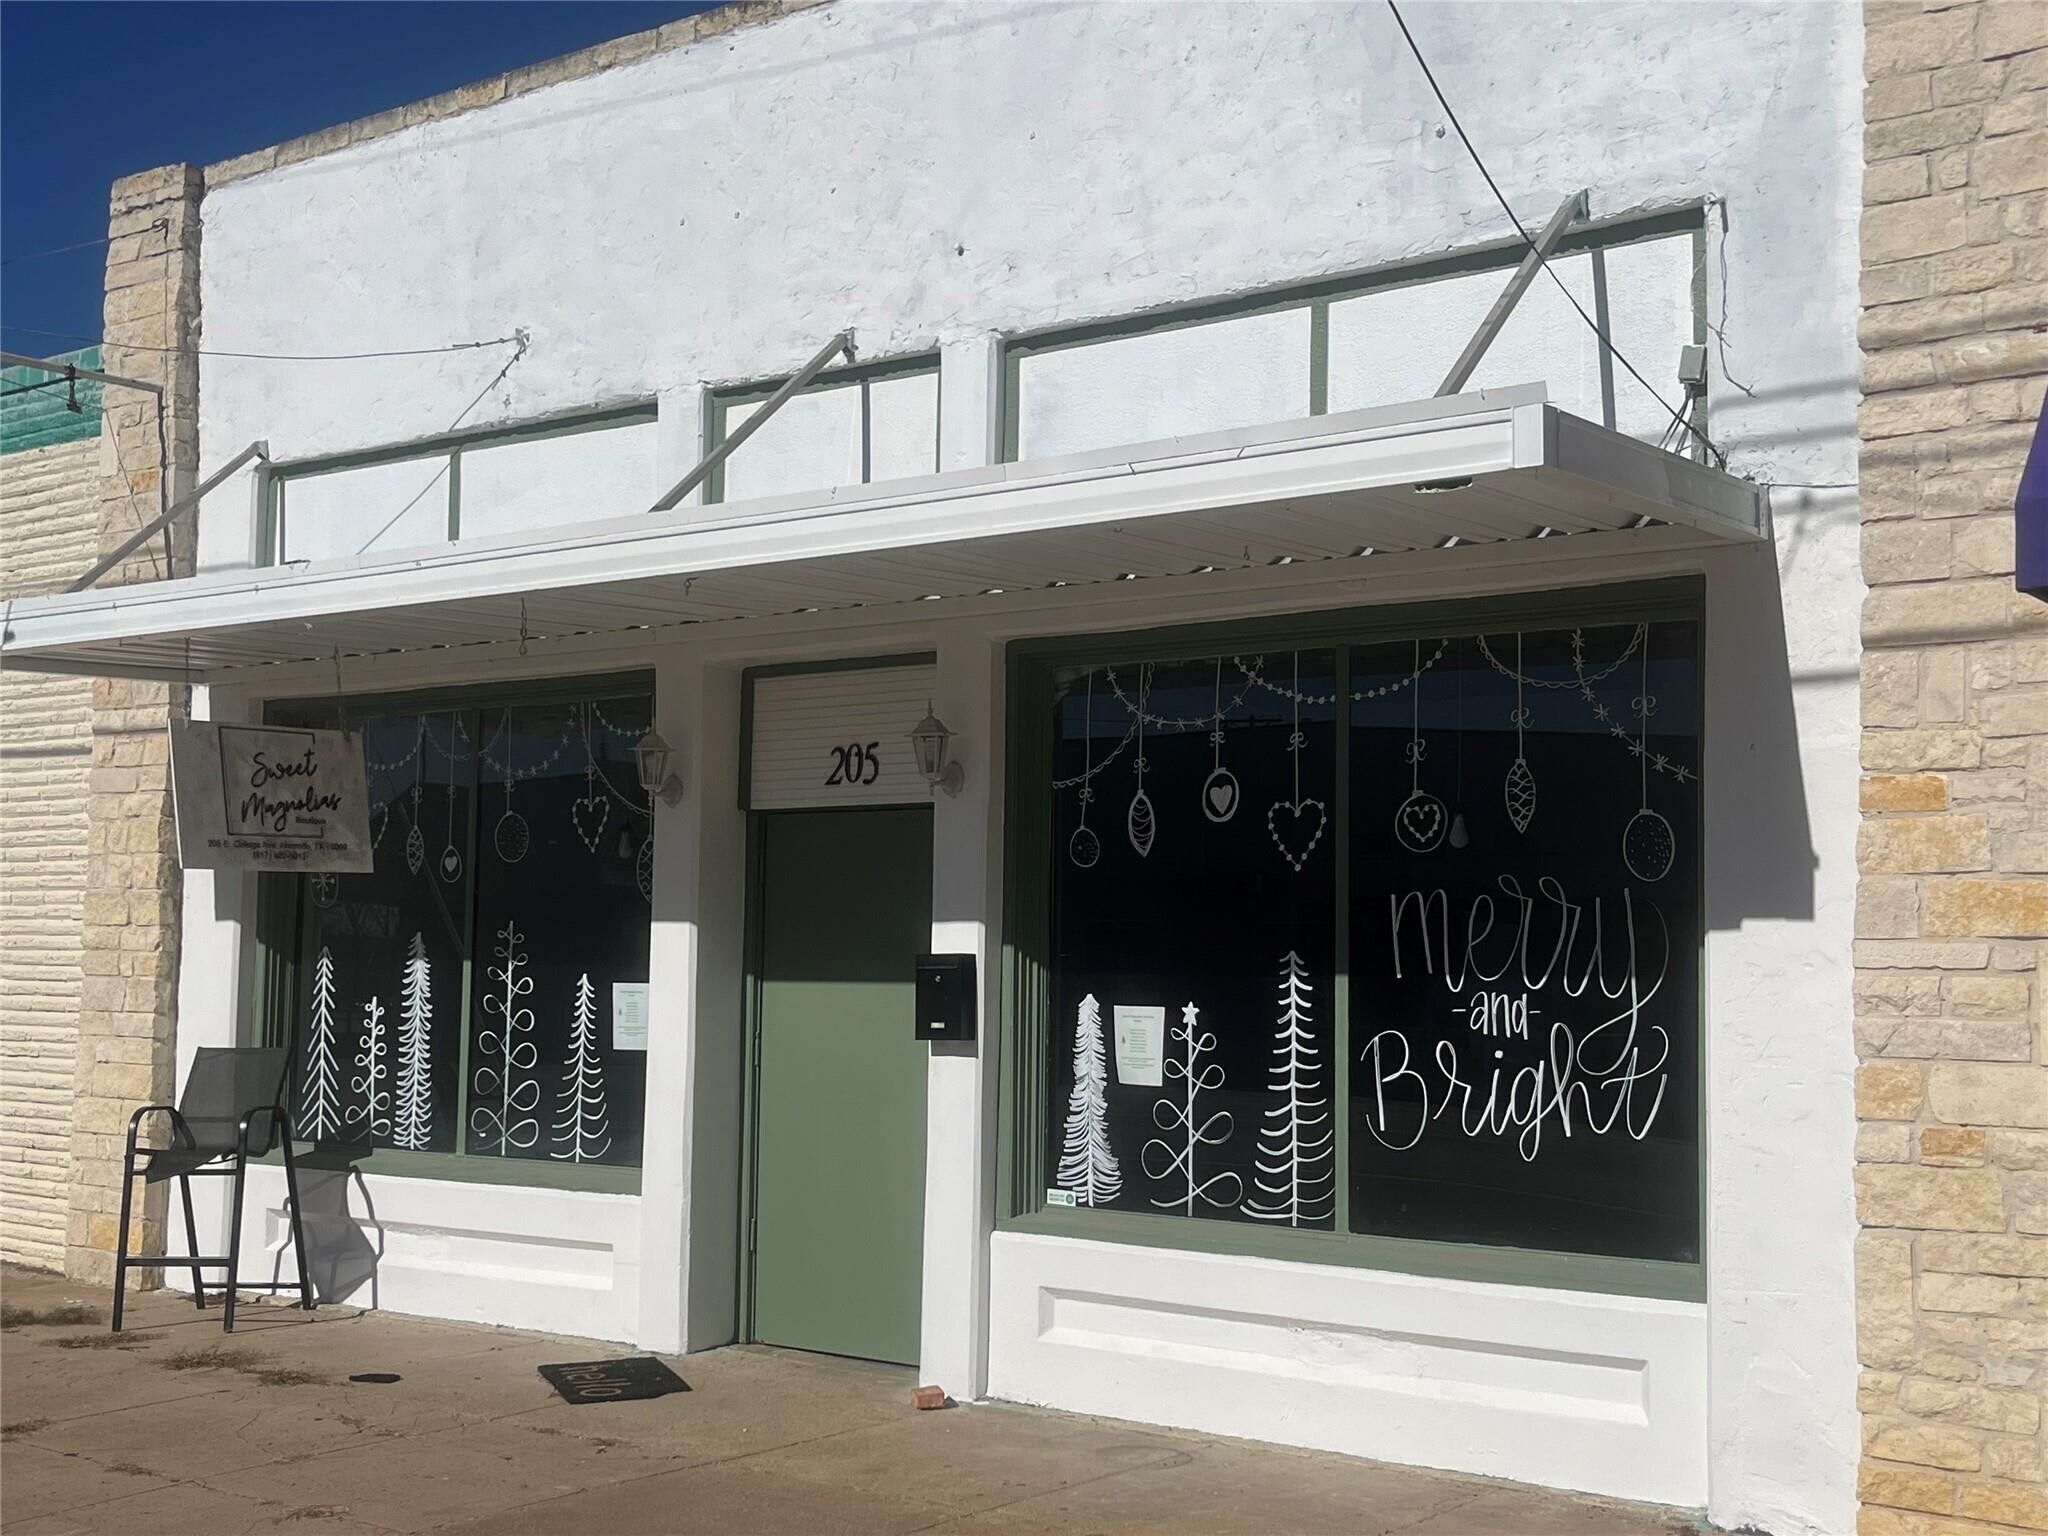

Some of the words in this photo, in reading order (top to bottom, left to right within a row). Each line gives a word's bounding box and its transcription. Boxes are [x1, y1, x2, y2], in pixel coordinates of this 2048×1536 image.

[251, 748, 318, 788] Sweet
[824, 741, 880, 785] 205
[241, 785, 342, 832] Magnolias
[1360, 1022, 1669, 1162] Bright
[557, 1364, 633, 1397] hello
